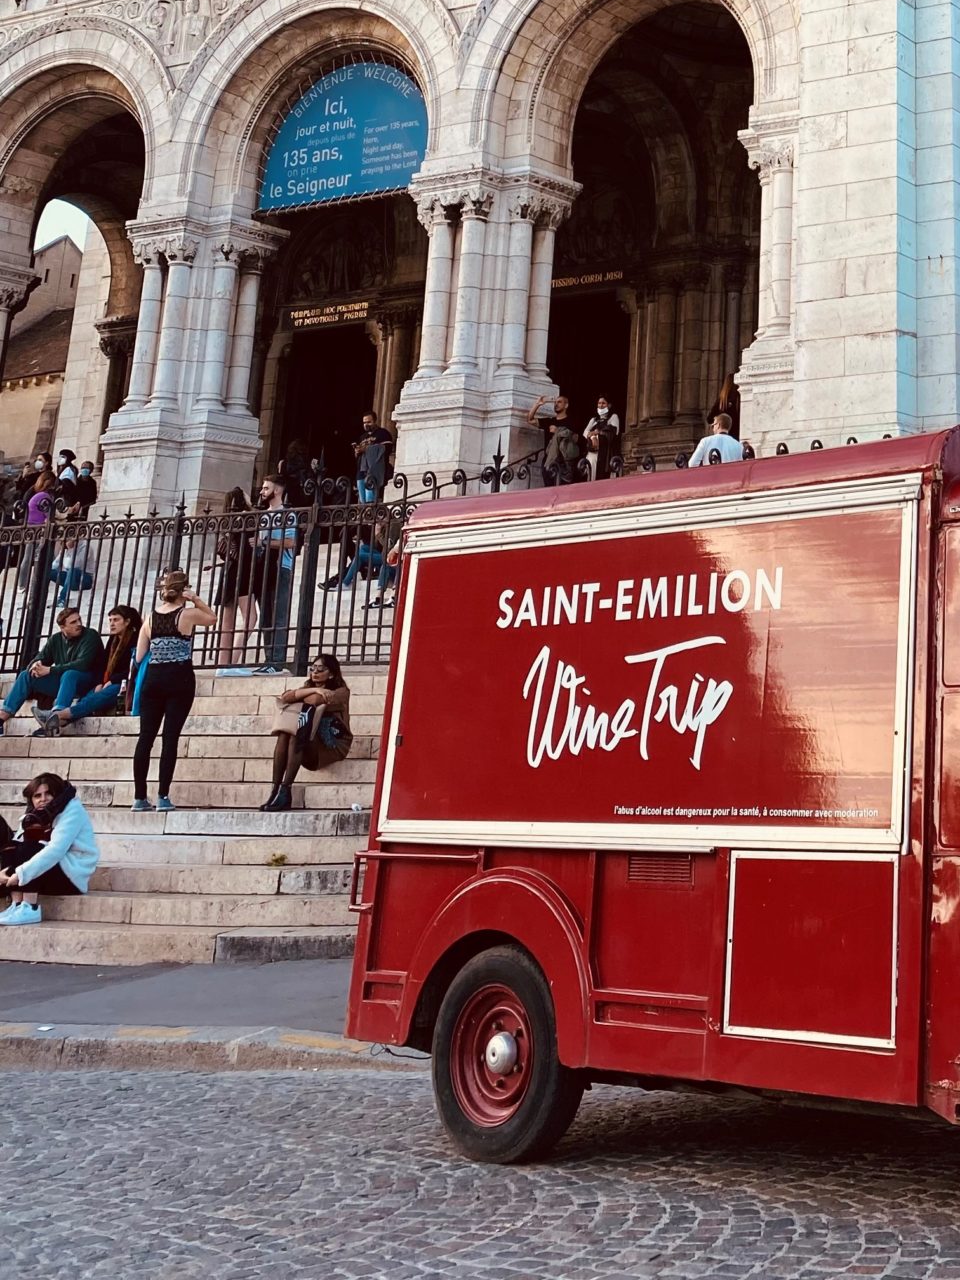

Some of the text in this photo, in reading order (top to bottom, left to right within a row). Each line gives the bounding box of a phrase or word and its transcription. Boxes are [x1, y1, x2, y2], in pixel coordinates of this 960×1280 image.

[294, 66, 414, 118] BIENVENUE WELCOME
[324, 96, 348, 116] Ici,
[295, 117, 357, 140] jour et nuit,
[390, 121, 401, 129] 135
[307, 131, 356, 147] depuis plus de
[379, 144, 392, 152] and
[283, 147, 343, 168] 135 ans,
[361, 155, 390, 165] Someone
[403, 150, 418, 158] been
[287, 165, 318, 177] on prie
[360, 166, 384, 177] praying
[402, 159, 417, 169] Lord
[269, 173, 352, 198] le Seigneur
[496, 566, 783, 630] SAINT-EMILION
[522, 635, 734, 771] Wine Trip
[613, 805, 635, 816] l'abus
[635, 805, 662, 816] d'alcool
[663, 808, 674, 816] est
[674, 806, 712, 818] dangereux
[712, 808, 731, 818] pour
[731, 807, 738, 816] la
[739, 806, 762, 818] santé,
[769, 808, 814, 818] consommer
[814, 808, 833, 818] avec
